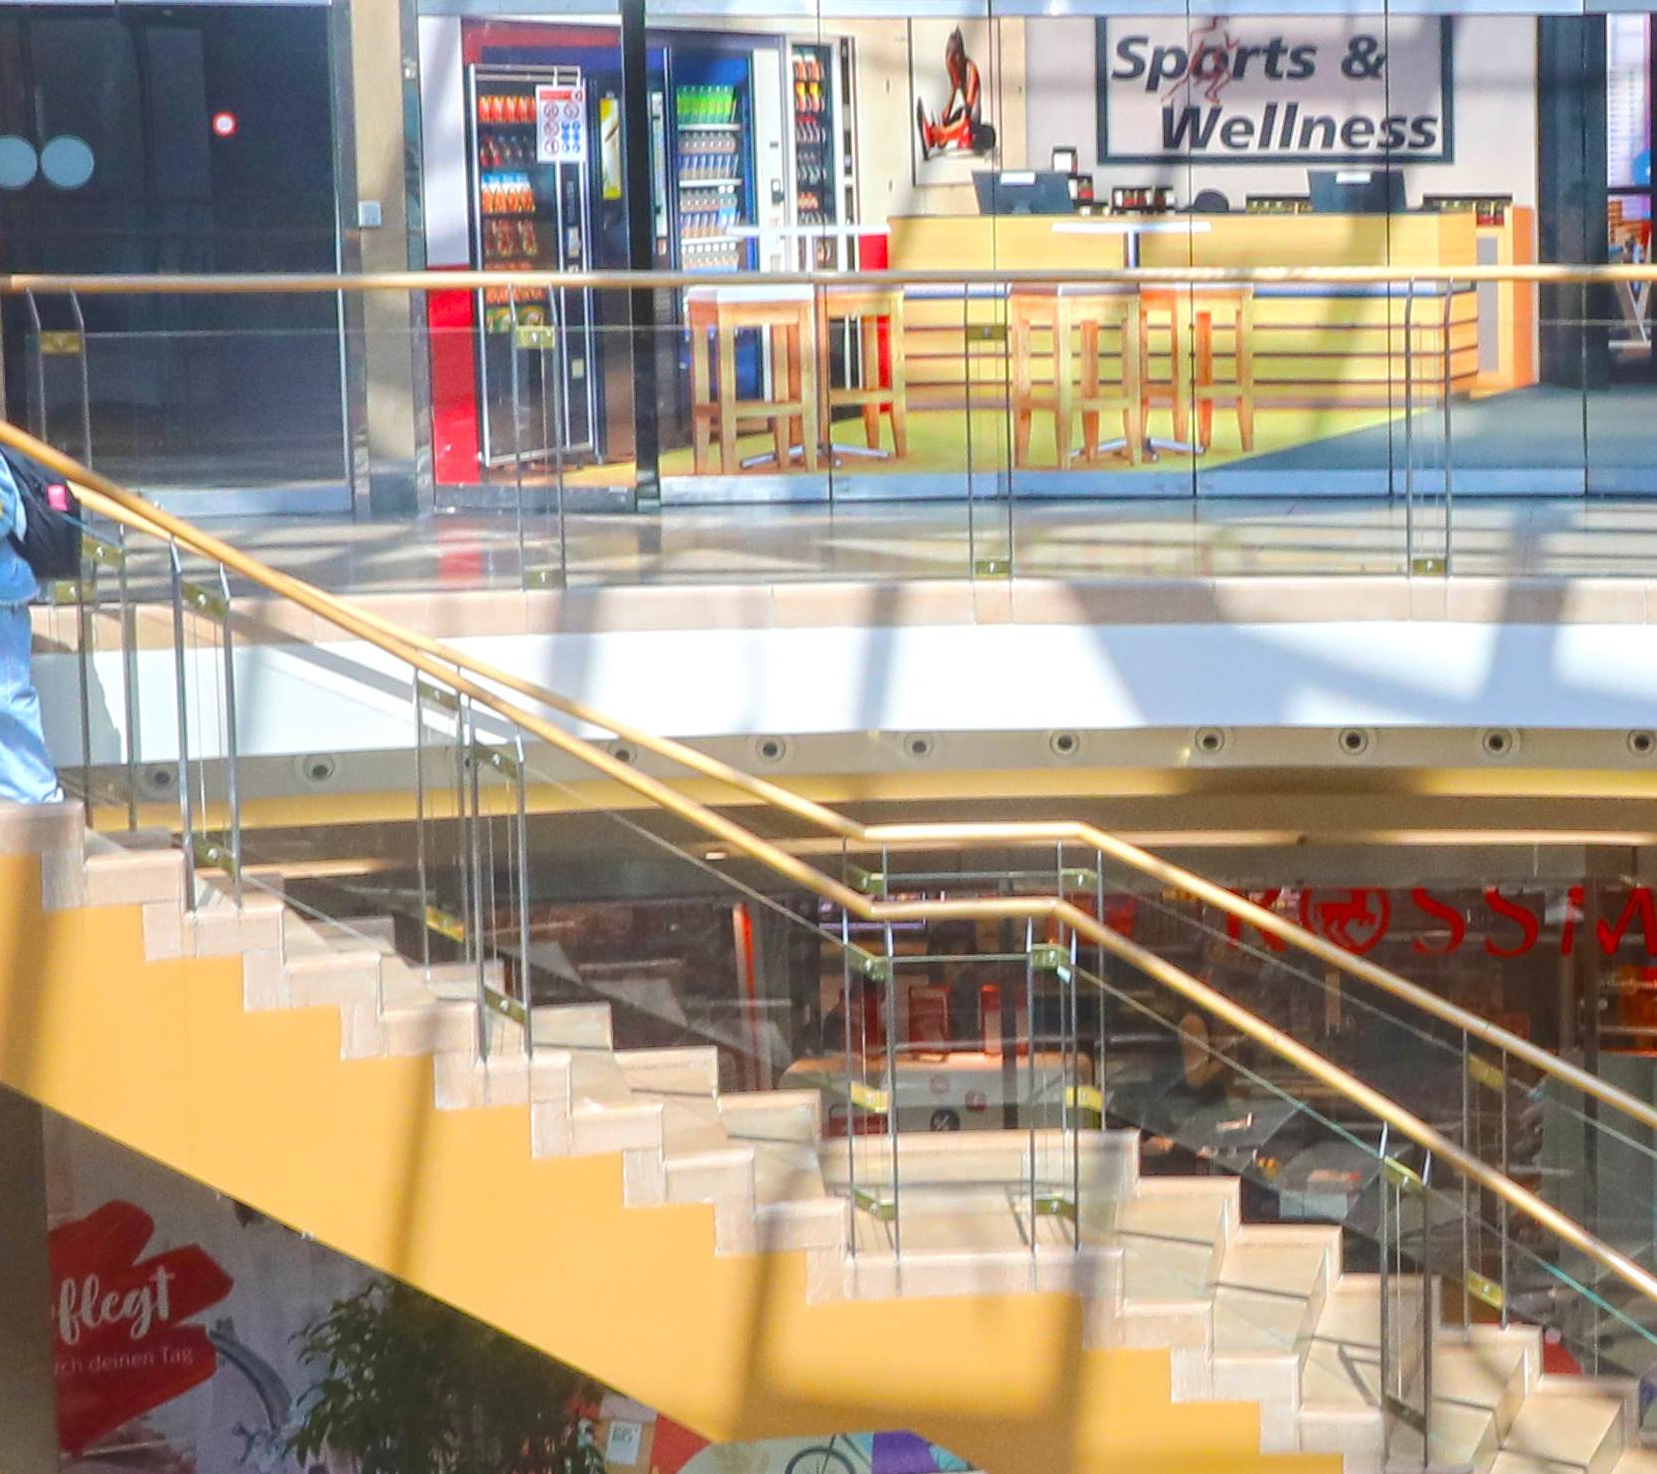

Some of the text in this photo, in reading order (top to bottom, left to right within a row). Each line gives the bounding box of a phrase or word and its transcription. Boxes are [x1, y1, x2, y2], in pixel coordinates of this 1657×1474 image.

[1111, 34, 1387, 93] Sports &
[1161, 102, 1438, 151] Wellness
